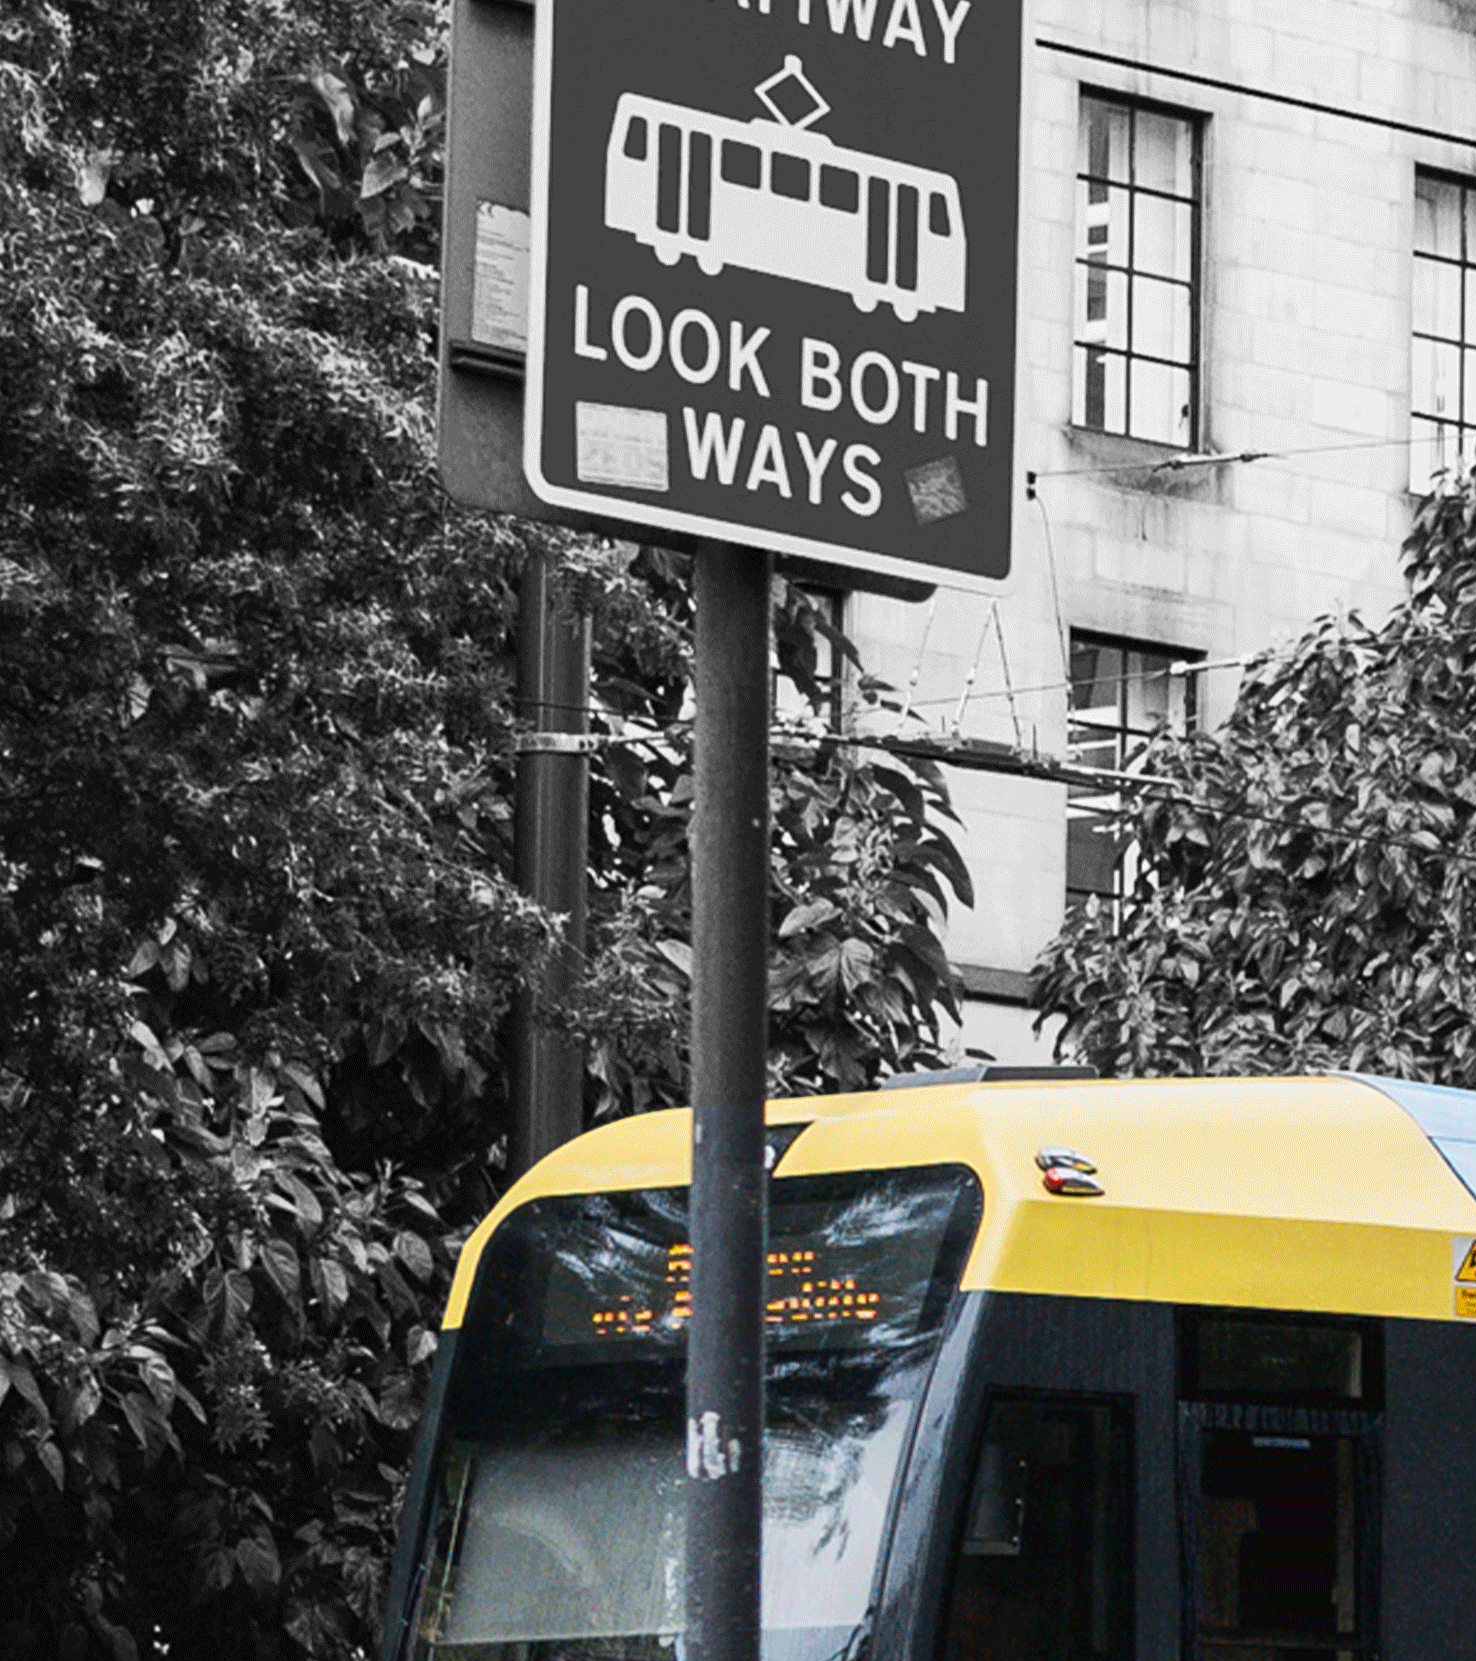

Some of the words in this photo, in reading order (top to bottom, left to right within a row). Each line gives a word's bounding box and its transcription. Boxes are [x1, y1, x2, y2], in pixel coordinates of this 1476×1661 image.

[573, 283, 772, 398] LOOK
[801, 336, 990, 447] BOTH
[682, 405, 883, 517] WAYS
